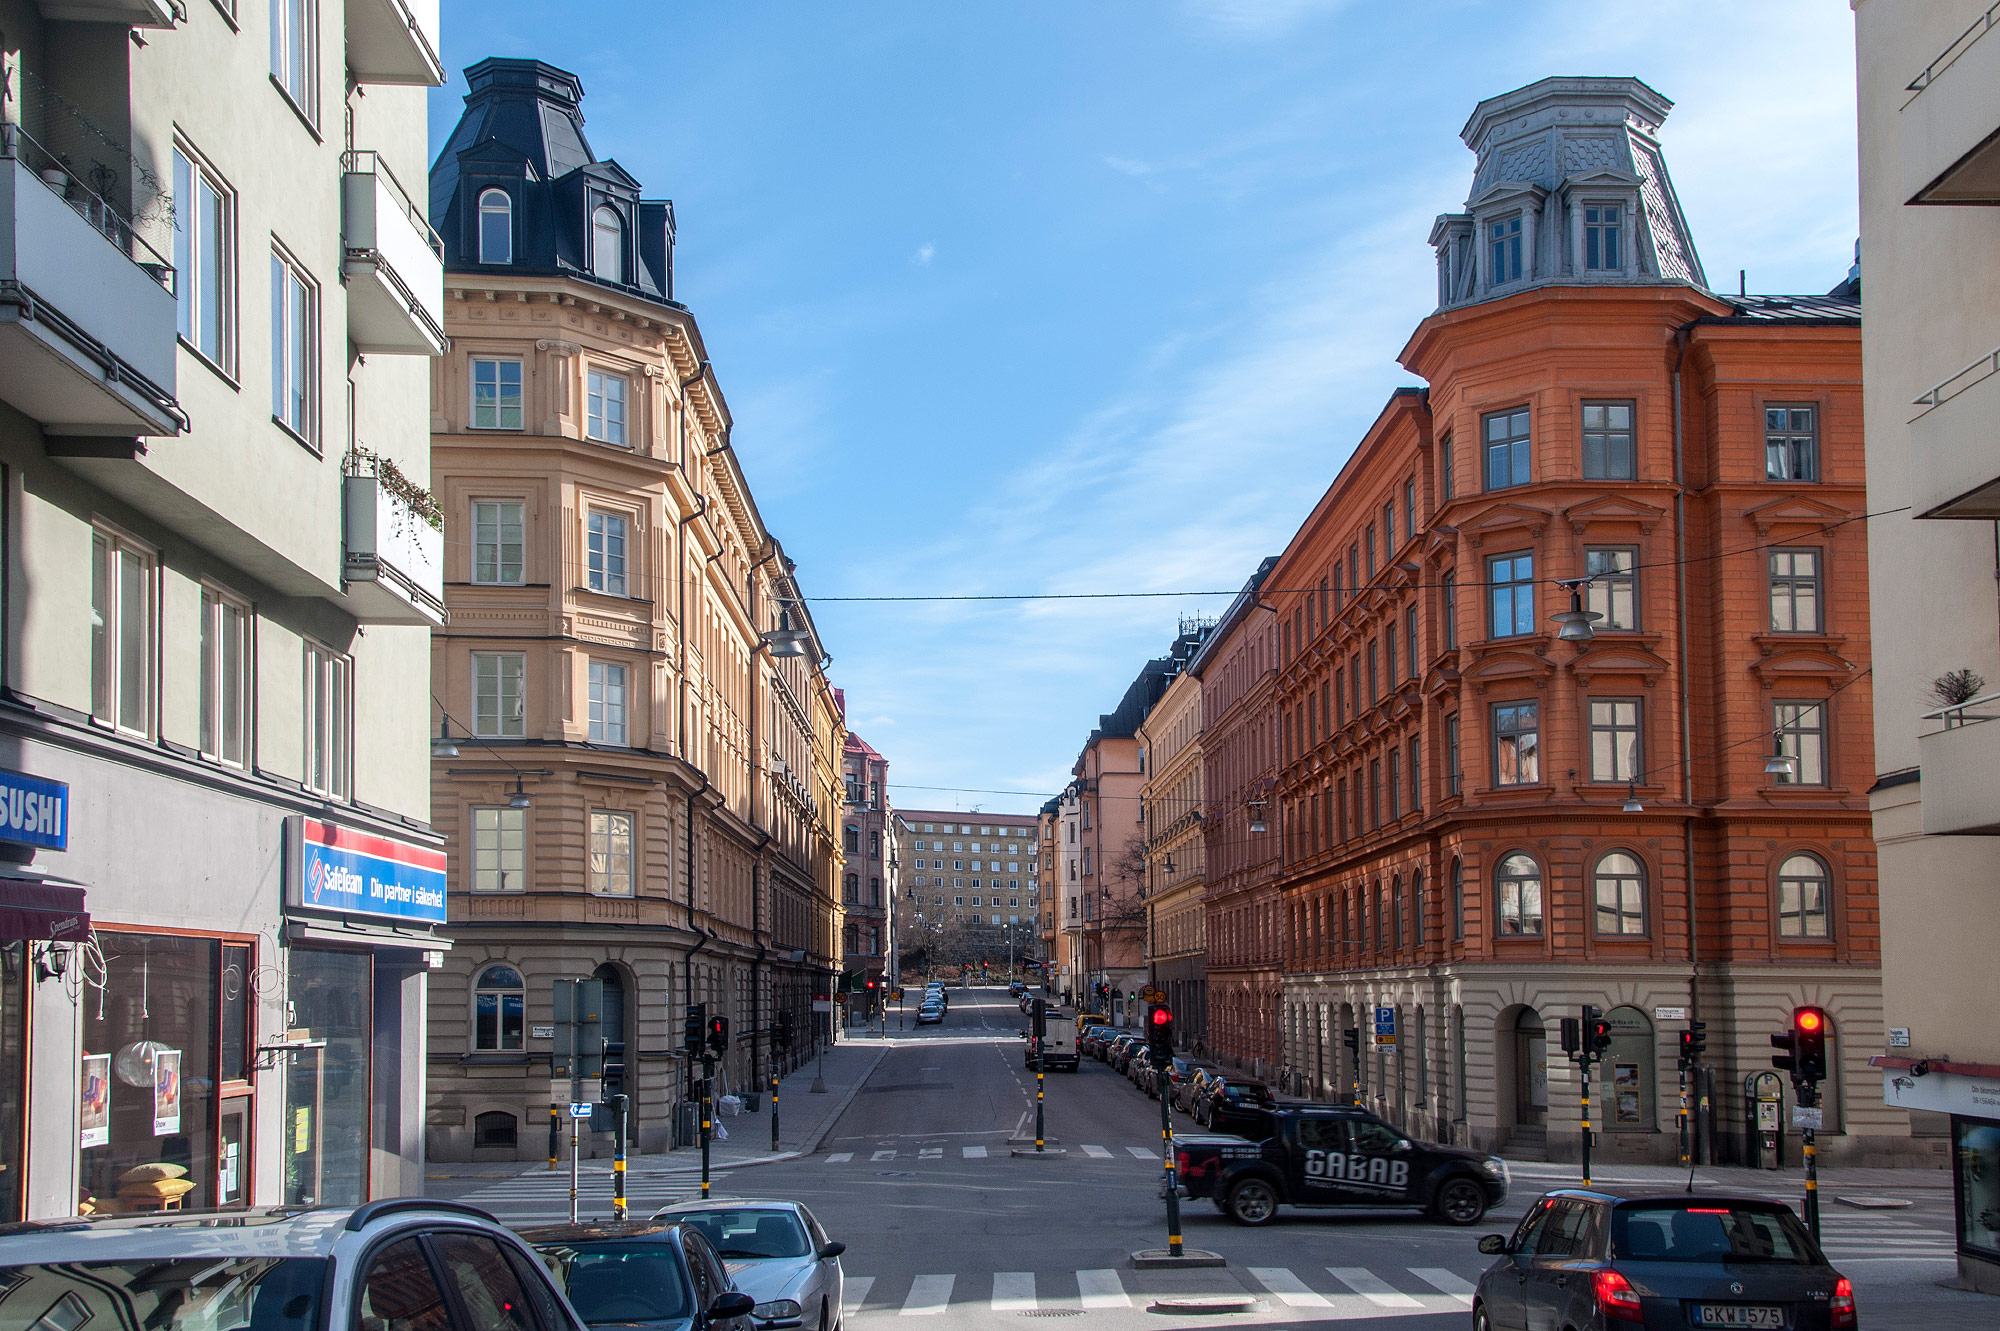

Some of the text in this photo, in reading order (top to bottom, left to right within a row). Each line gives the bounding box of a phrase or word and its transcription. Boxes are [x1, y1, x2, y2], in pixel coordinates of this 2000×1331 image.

[0, 785, 62, 836] SUSHI
[324, 863, 363, 895] SafeTeam
[370, 877, 383, 898] Din
[384, 882, 412, 904] partner
[415, 886, 443, 908] säkerhet
[1381, 1009, 1391, 1022] P
[1764, 1074, 1773, 1085] P
[1703, 1307, 1780, 1323] GKW 575
